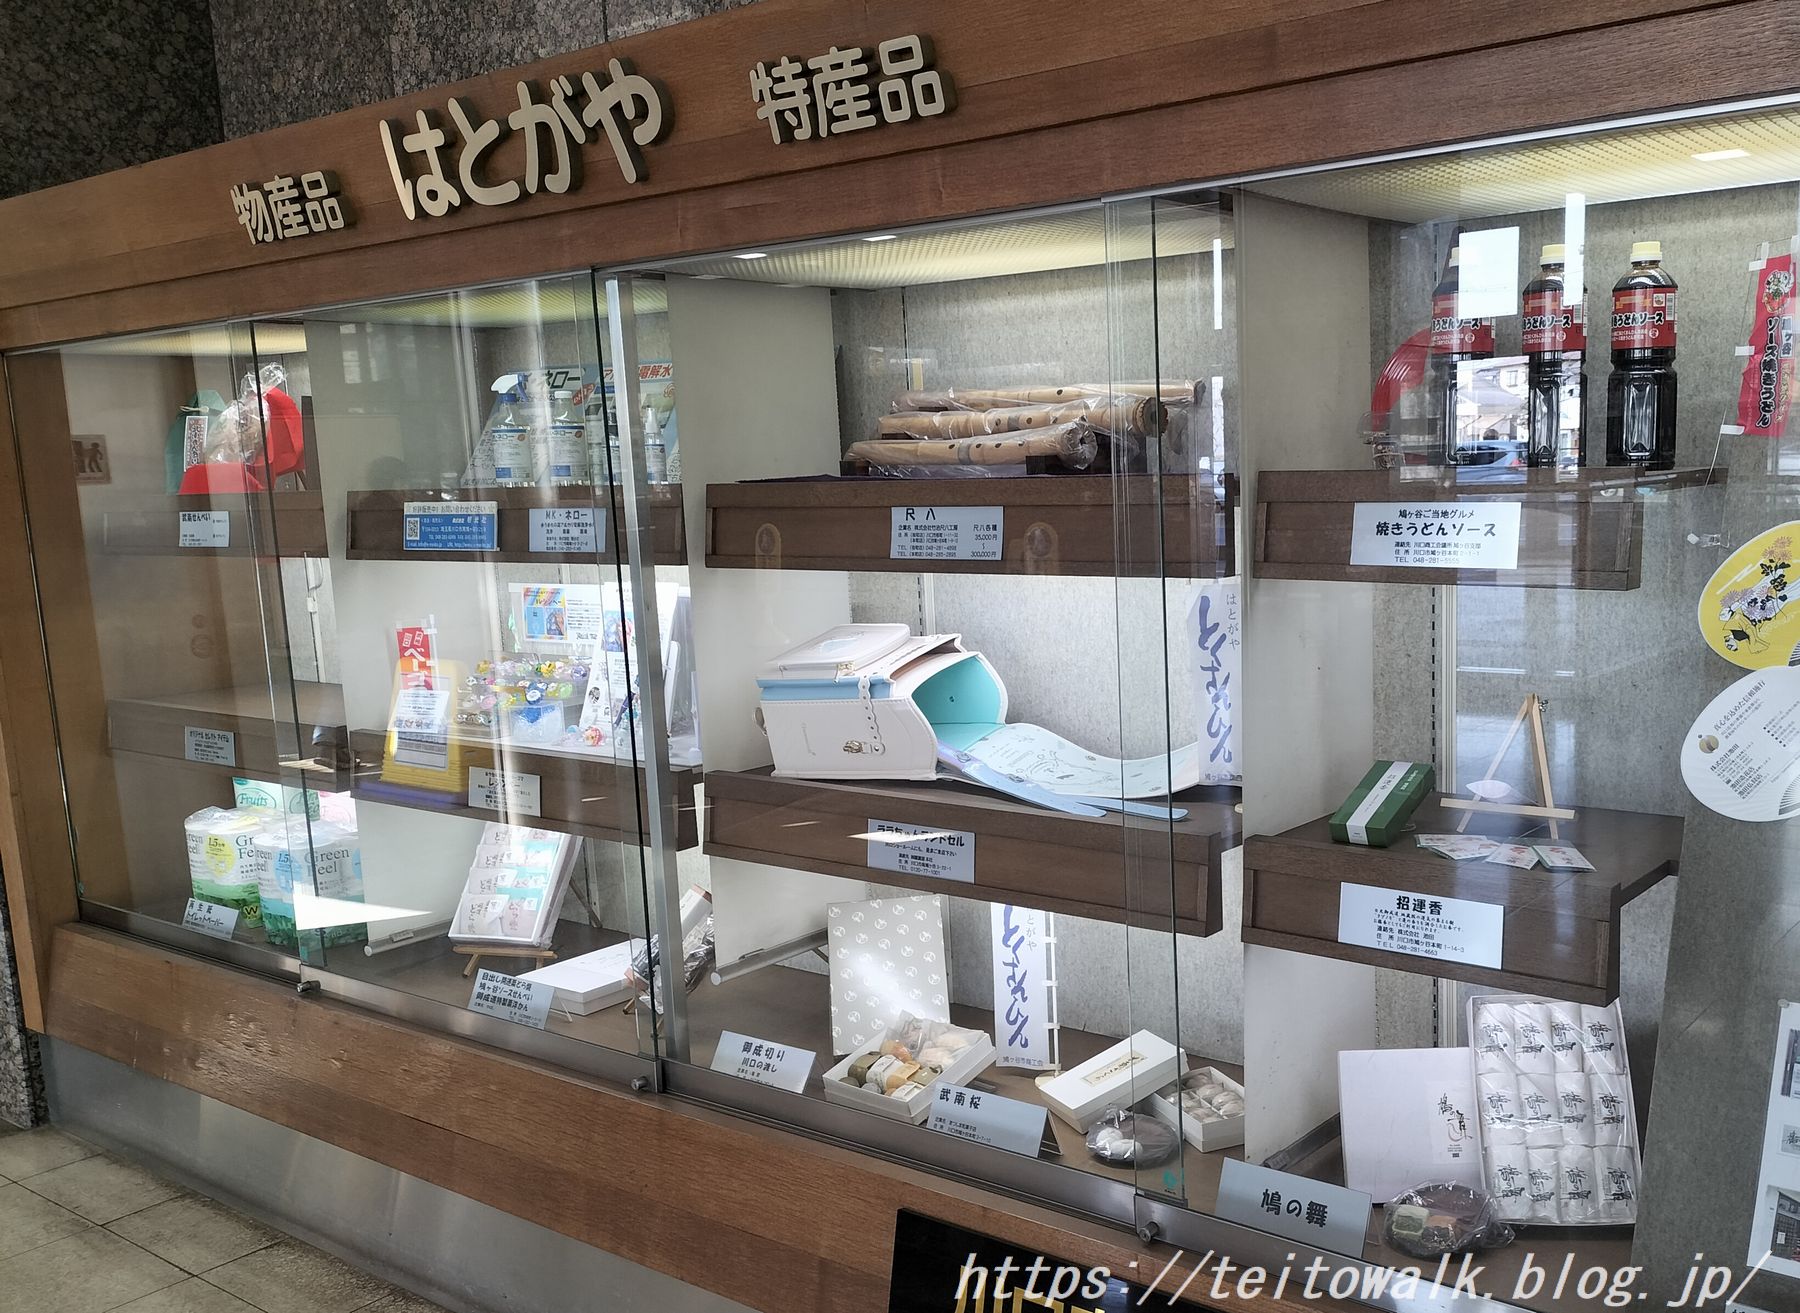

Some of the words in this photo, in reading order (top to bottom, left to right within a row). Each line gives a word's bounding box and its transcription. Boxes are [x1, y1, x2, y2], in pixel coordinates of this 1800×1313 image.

[229, 169, 345, 246] 物産品
[379, 56, 664, 222] はとがや
[749, 33, 946, 145] 特産品
[1398, 509, 1475, 519] 鳩ヶ谷ご当地グルメ
[1375, 521, 1497, 537] 焼きうどんソース
[1226, 593, 1241, 650] はとがや
[239, 792, 268, 806] Fruits
[1396, 895, 1443, 916] 招運香
[741, 1041, 785, 1061] 御成切り
[741, 1057, 778, 1073] 川口の渡し
[939, 1088, 982, 1109] 武南桜
[1260, 1188, 1328, 1229] 鳩の舞
